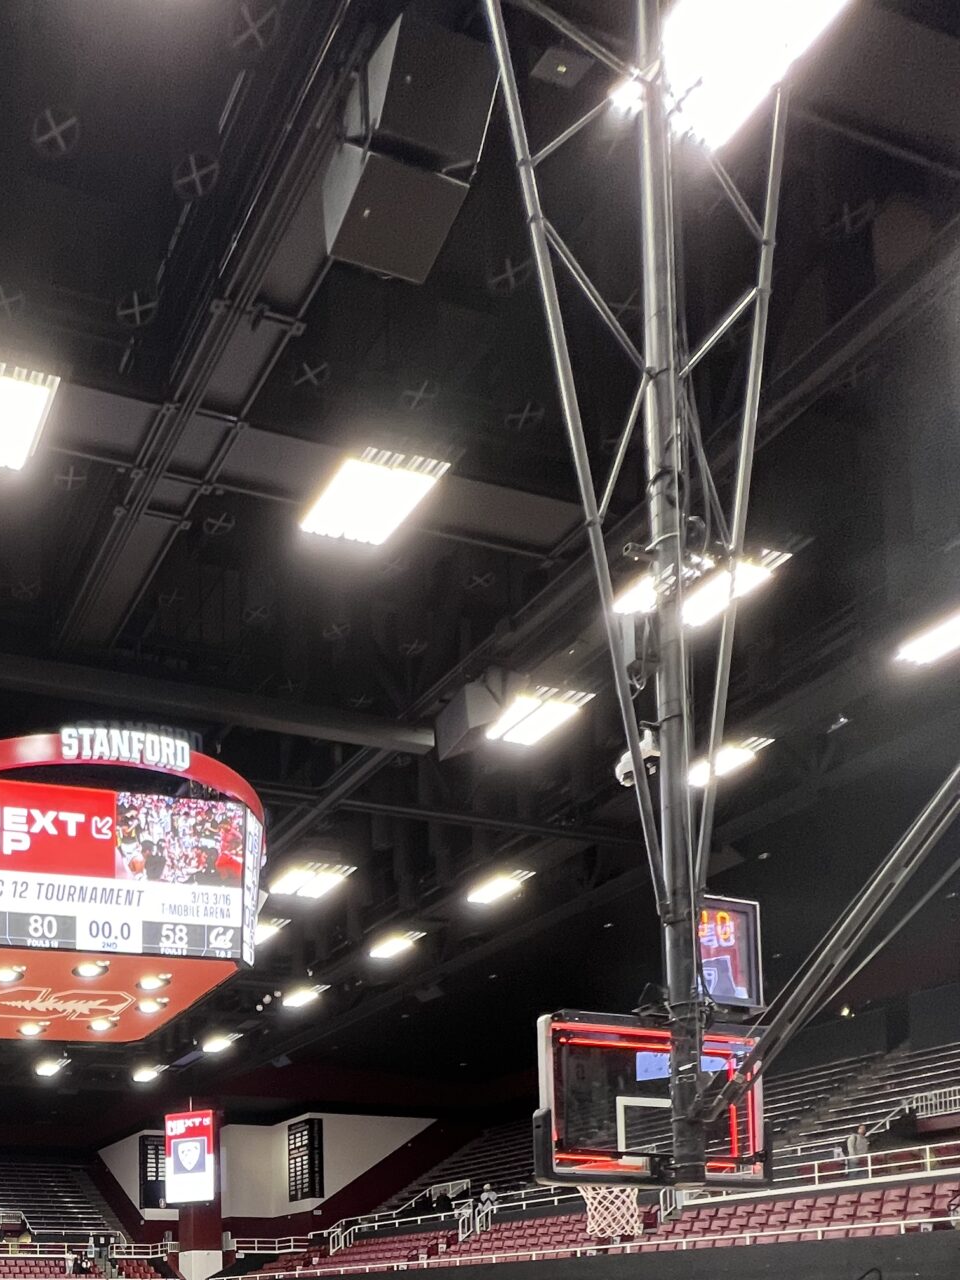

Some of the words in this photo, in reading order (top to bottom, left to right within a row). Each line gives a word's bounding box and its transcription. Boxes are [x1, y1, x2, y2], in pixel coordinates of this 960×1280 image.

[61, 727, 190, 771] STANFORD
[11, 880, 29, 899] 12
[36, 882, 145, 907] TOURNAMENT
[203, 905, 231, 919] ARENA
[28, 915, 58, 938] 80
[89, 920, 131, 941] 00.0
[160, 923, 188, 945] 58
